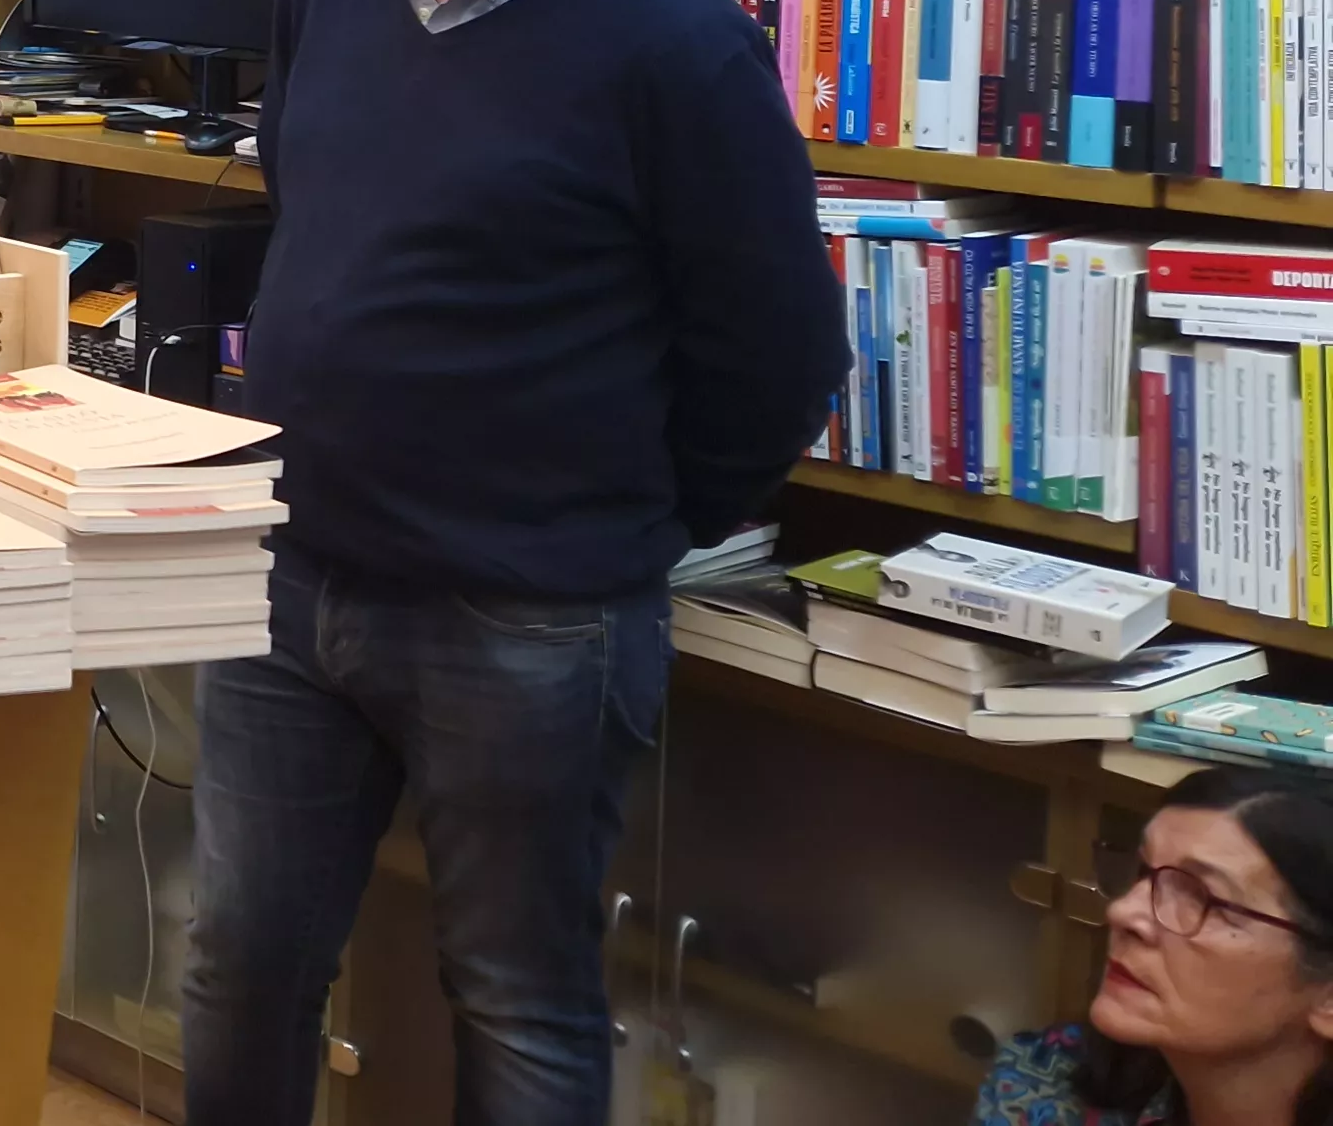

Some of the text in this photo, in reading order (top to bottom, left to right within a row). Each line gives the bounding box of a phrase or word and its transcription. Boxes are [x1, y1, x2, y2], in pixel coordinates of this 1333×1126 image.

[820, 40, 833, 53] LA
[1012, 261, 1025, 315] INFANCIA
[1309, 495, 1318, 527] ROJAS
